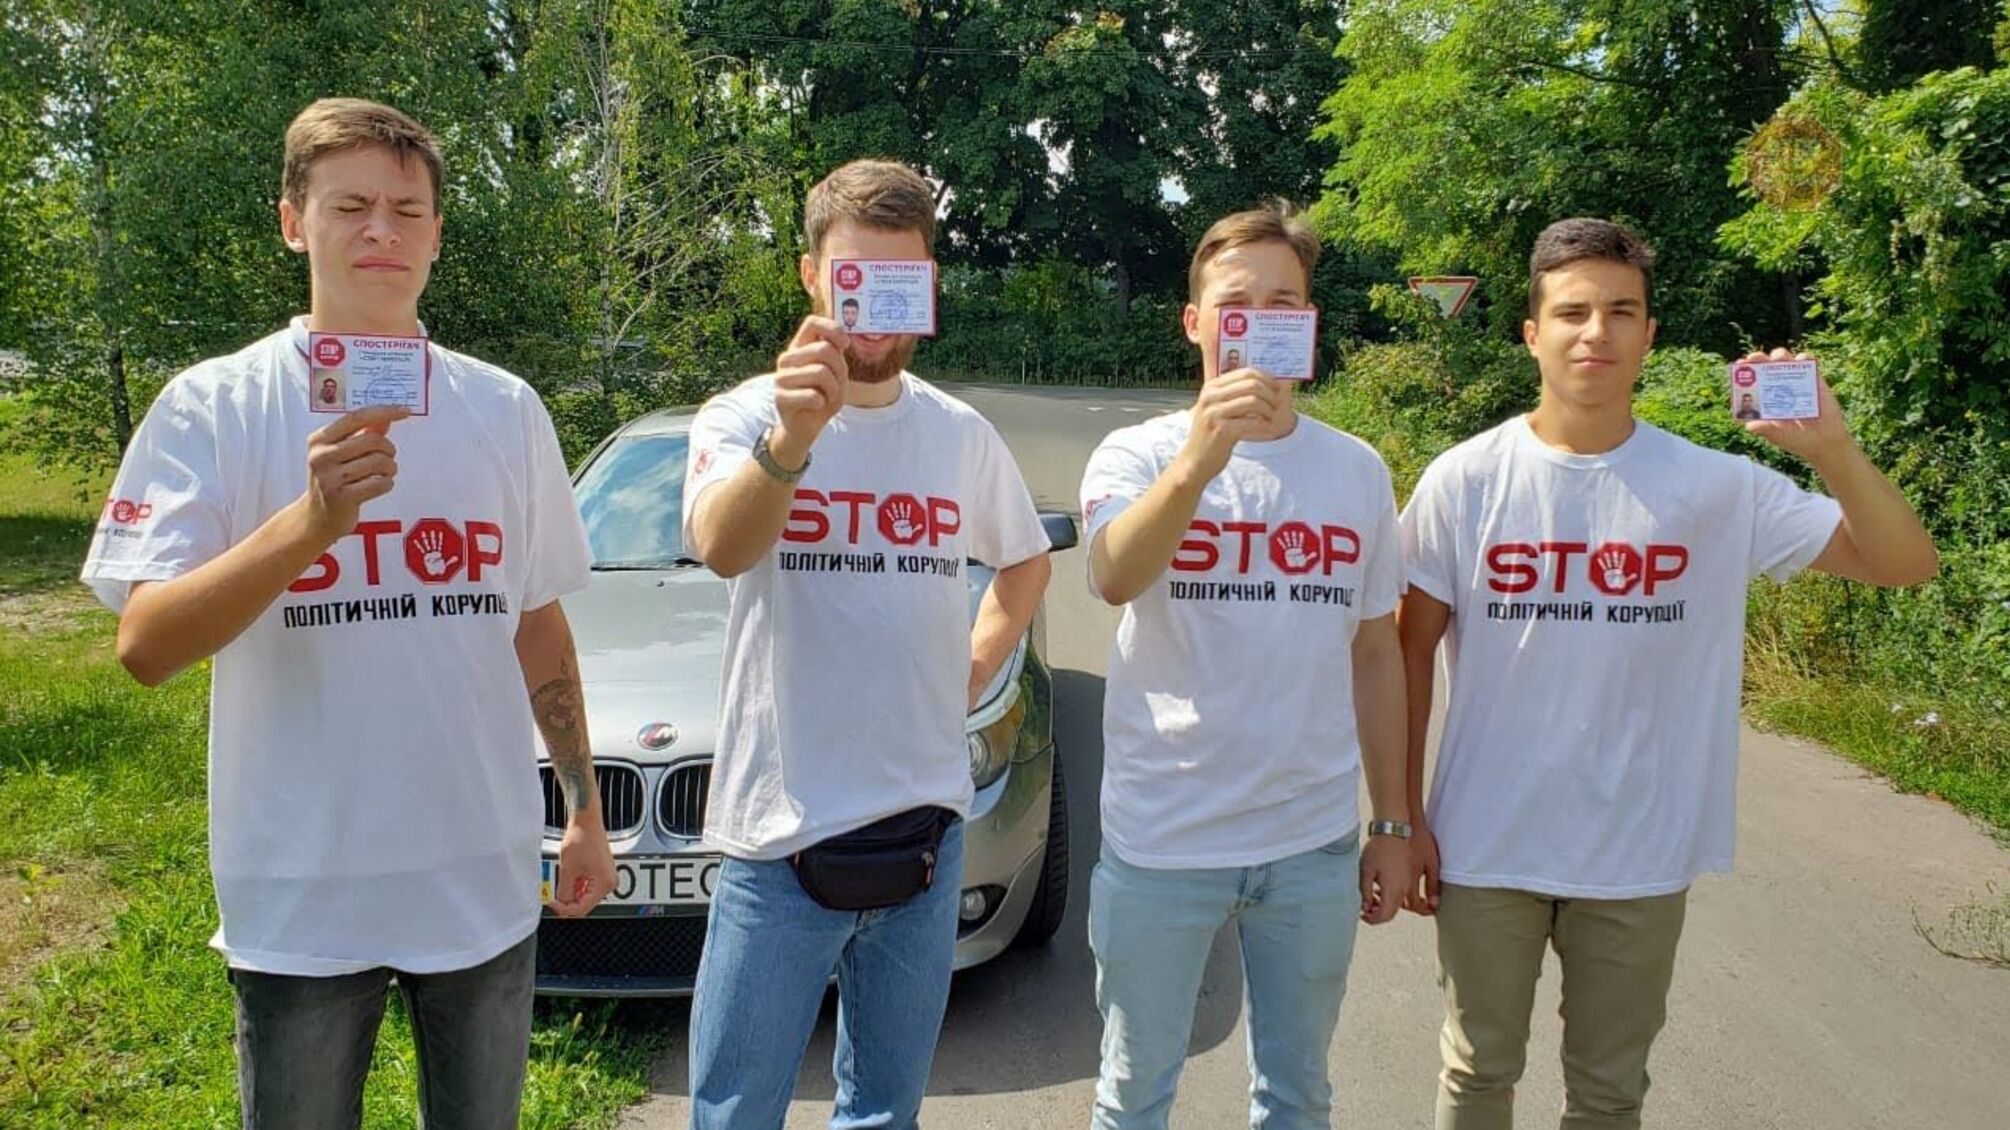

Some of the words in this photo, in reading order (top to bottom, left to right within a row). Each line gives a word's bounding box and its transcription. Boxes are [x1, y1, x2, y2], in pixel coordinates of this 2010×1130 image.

[781, 489, 961, 547] STOP
[1170, 519, 1361, 576] STOP
[1486, 542, 1688, 596] STOP
[284, 593, 417, 629] ПОЛІТИЧНІЙ
[1487, 601, 1593, 622] ПОЛІТИЧНІЙ
[1607, 599, 1686, 623] КОРУПЦІЇ
